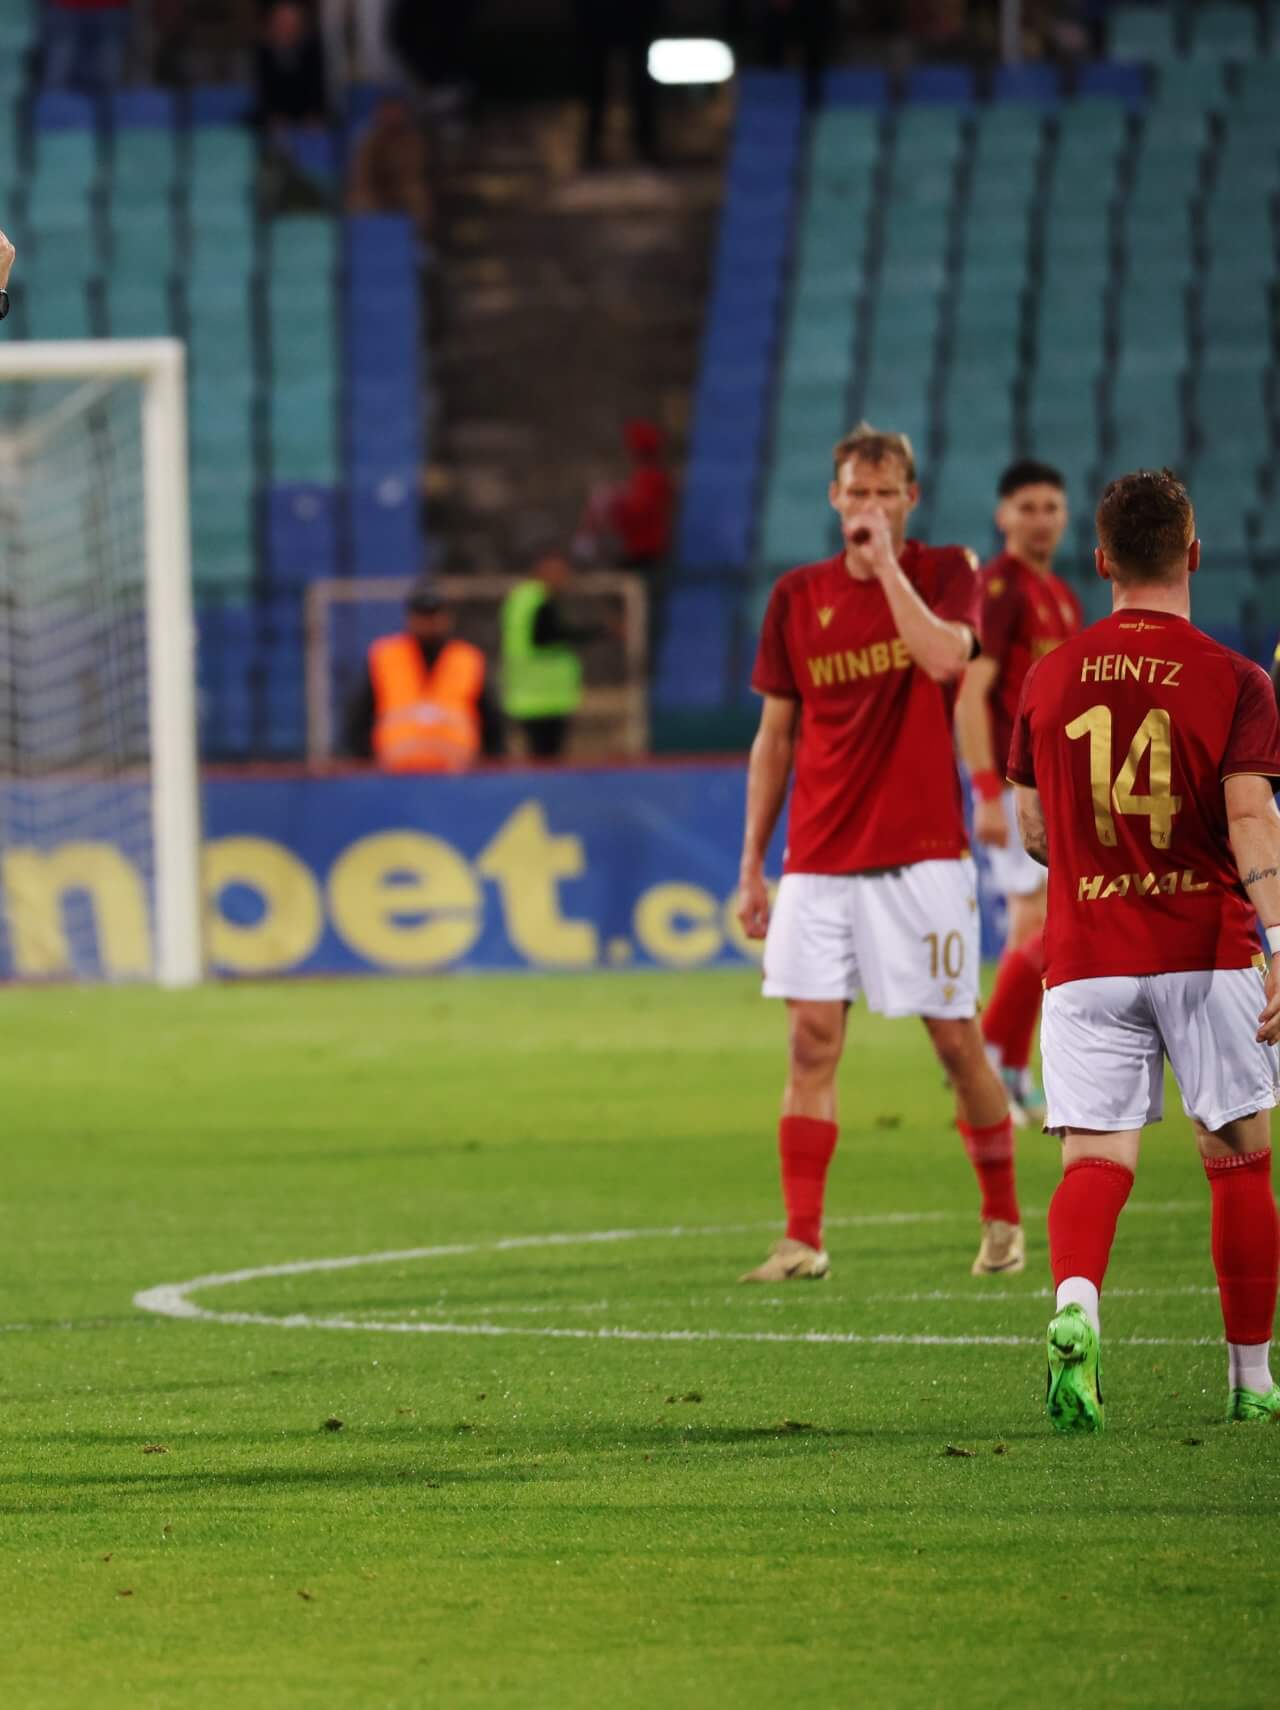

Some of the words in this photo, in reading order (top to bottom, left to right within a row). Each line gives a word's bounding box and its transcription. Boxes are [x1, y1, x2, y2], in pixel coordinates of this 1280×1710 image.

[808, 638, 913, 688] WINBE
[1081, 654, 1183, 687] HEINTZ
[1065, 705, 1182, 850] 14
[923, 929, 964, 979] 10
